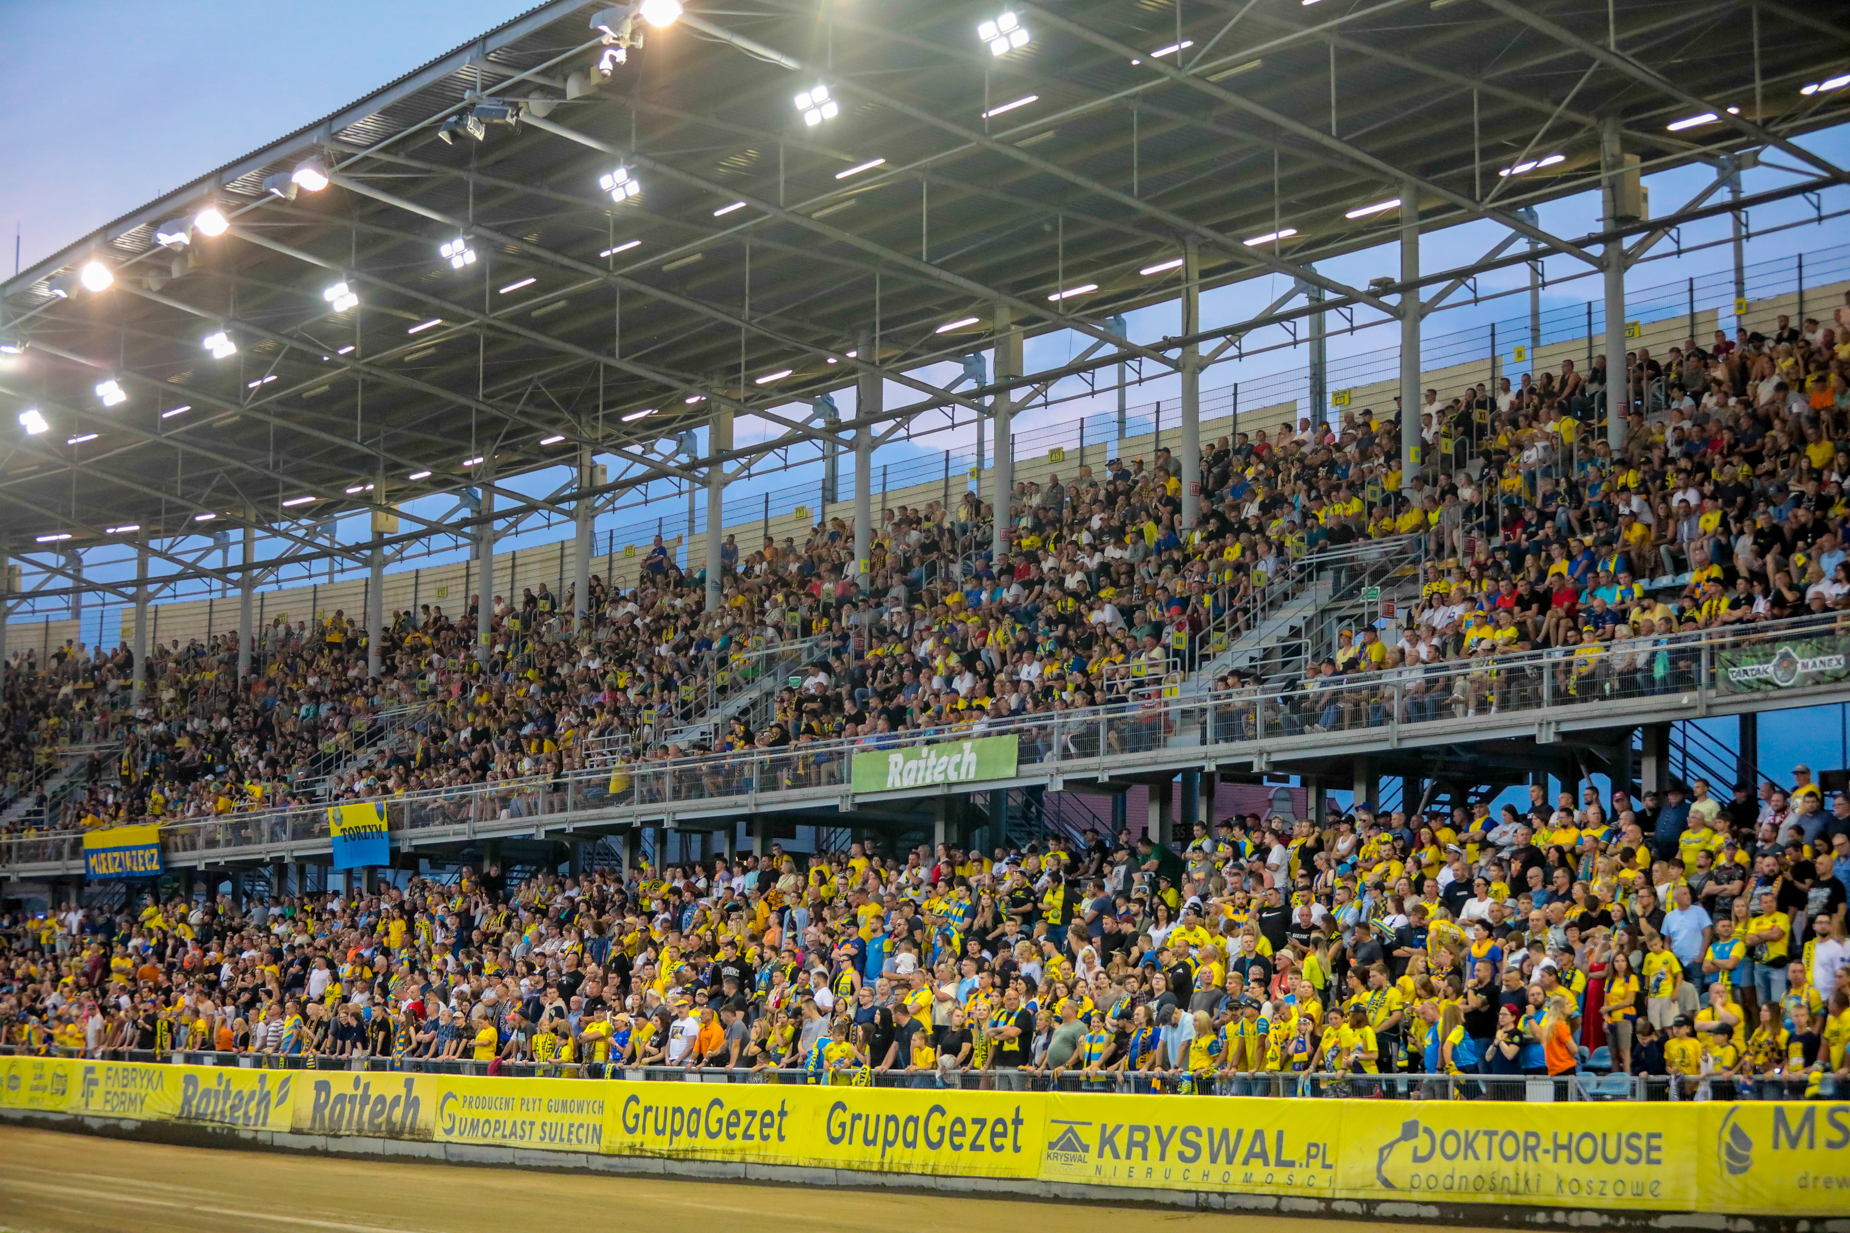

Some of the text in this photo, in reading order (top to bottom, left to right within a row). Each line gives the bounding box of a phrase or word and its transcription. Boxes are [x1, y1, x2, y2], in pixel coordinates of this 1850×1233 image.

[1175, 636, 1183, 645] III
[1729, 665, 1770, 679] TARTAK
[1801, 656, 1843, 671] MANEX
[886, 742, 977, 788] Raitech
[340, 824, 385, 843] TORZYM
[105, 1066, 164, 1091] FABRYKA
[103, 1090, 148, 1113] FORMY
[178, 1071, 271, 1127] Raitech
[310, 1075, 420, 1131] Raitech
[462, 1094, 604, 1115] PRODUCENT PŁYT GUMOWYCH
[538, 1120, 602, 1146] SULĘCIN
[622, 1094, 788, 1148] GrupaGezet
[826, 1100, 1024, 1159] GrupaGezet
[1772, 1104, 1850, 1150] MS
[1046, 1151, 1088, 1164] KRYSWAL
[1097, 1123, 1334, 1170] KRYSWAL.PL
[1411, 1126, 1662, 1165] DOKTOR-HOUSE
[1408, 1168, 1662, 1198] podnośniki koszowe
